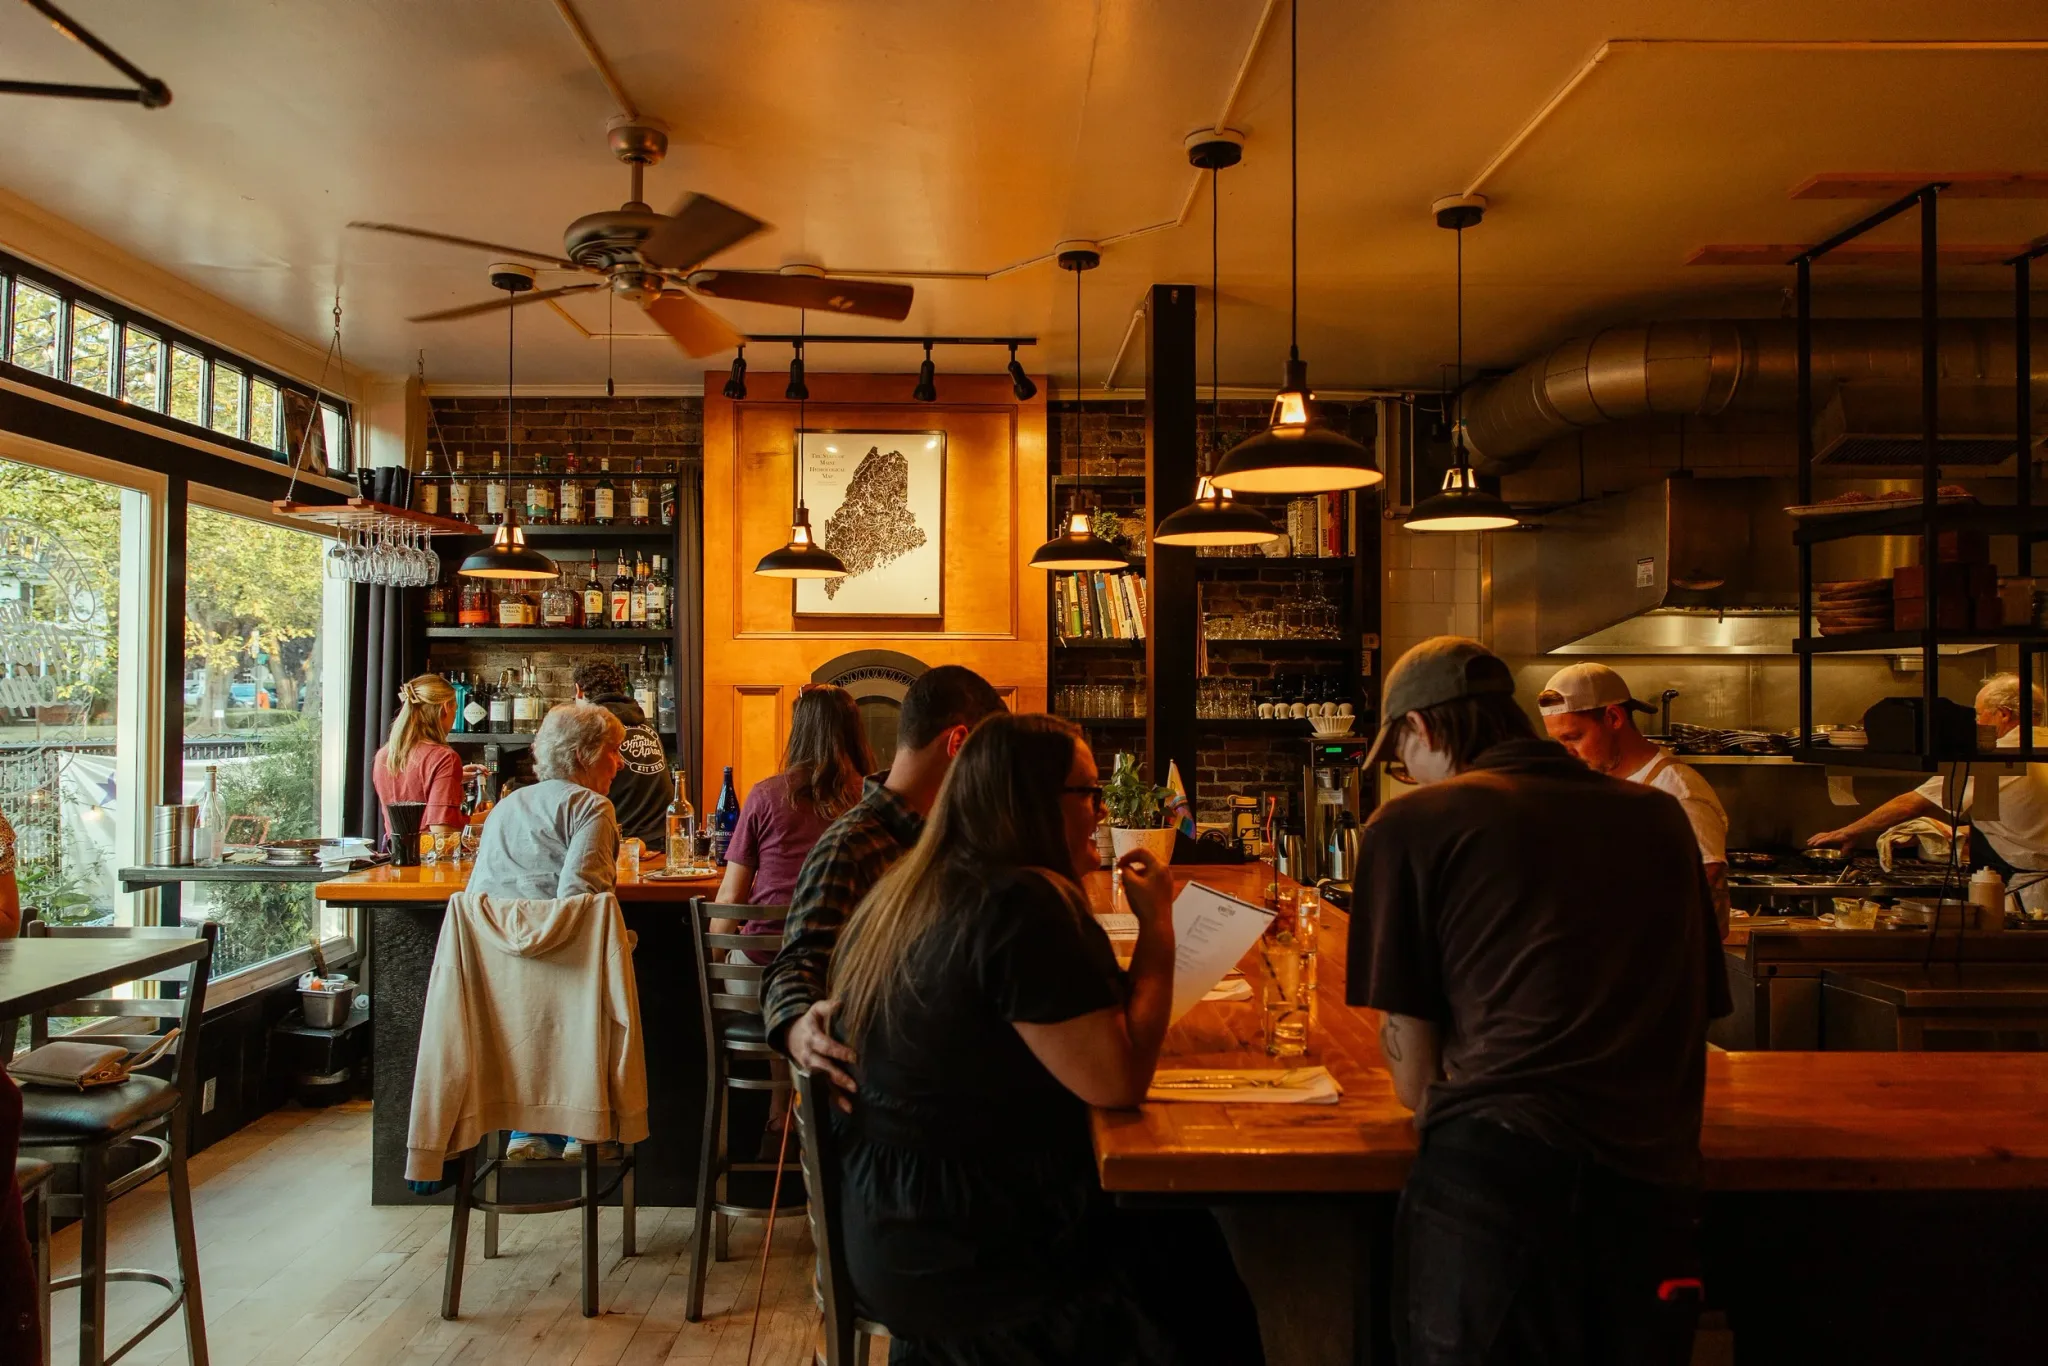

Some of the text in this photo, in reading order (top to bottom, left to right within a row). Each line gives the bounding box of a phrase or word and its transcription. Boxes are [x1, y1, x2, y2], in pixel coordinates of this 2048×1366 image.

[613, 598, 628, 619] 7
[1138, 597, 1146, 618] BESTIA
[619, 737, 658, 753] Knotted
[632, 746, 662, 758] Apron
